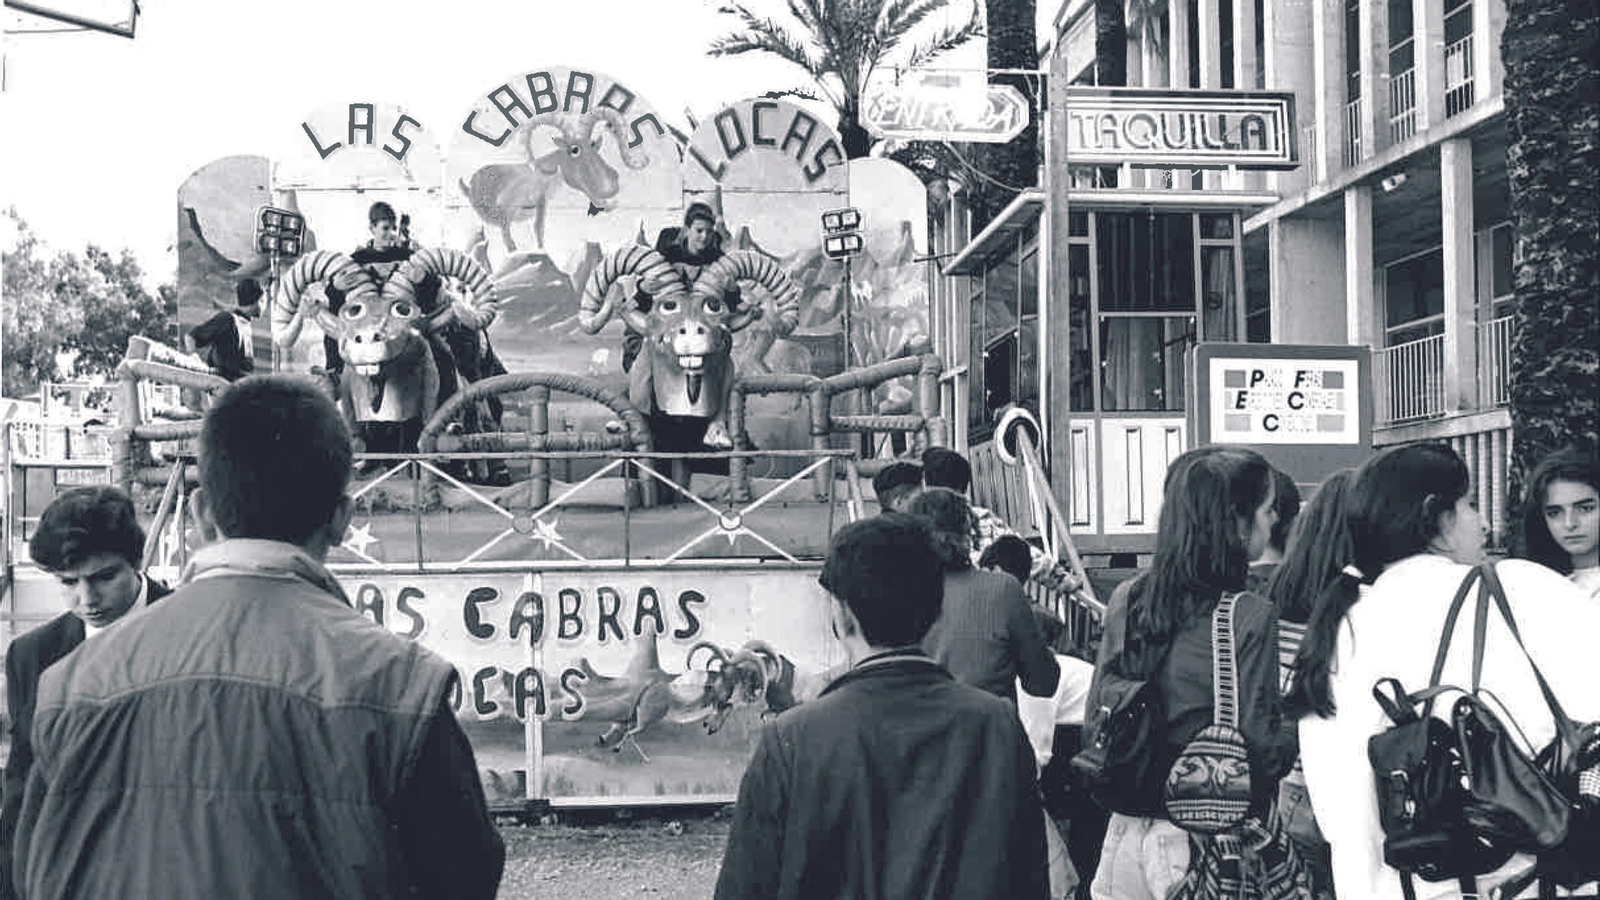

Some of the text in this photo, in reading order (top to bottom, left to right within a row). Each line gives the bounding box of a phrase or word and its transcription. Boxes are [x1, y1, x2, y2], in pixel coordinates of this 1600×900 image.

[301, 71, 843, 182] LAS CABRAS LOCAS
[866, 93, 1014, 133] ENTRDA
[1071, 111, 1267, 151] TAQUILLA
[356, 583, 705, 645] AS CABRAS
[451, 666, 587, 719] CAS
